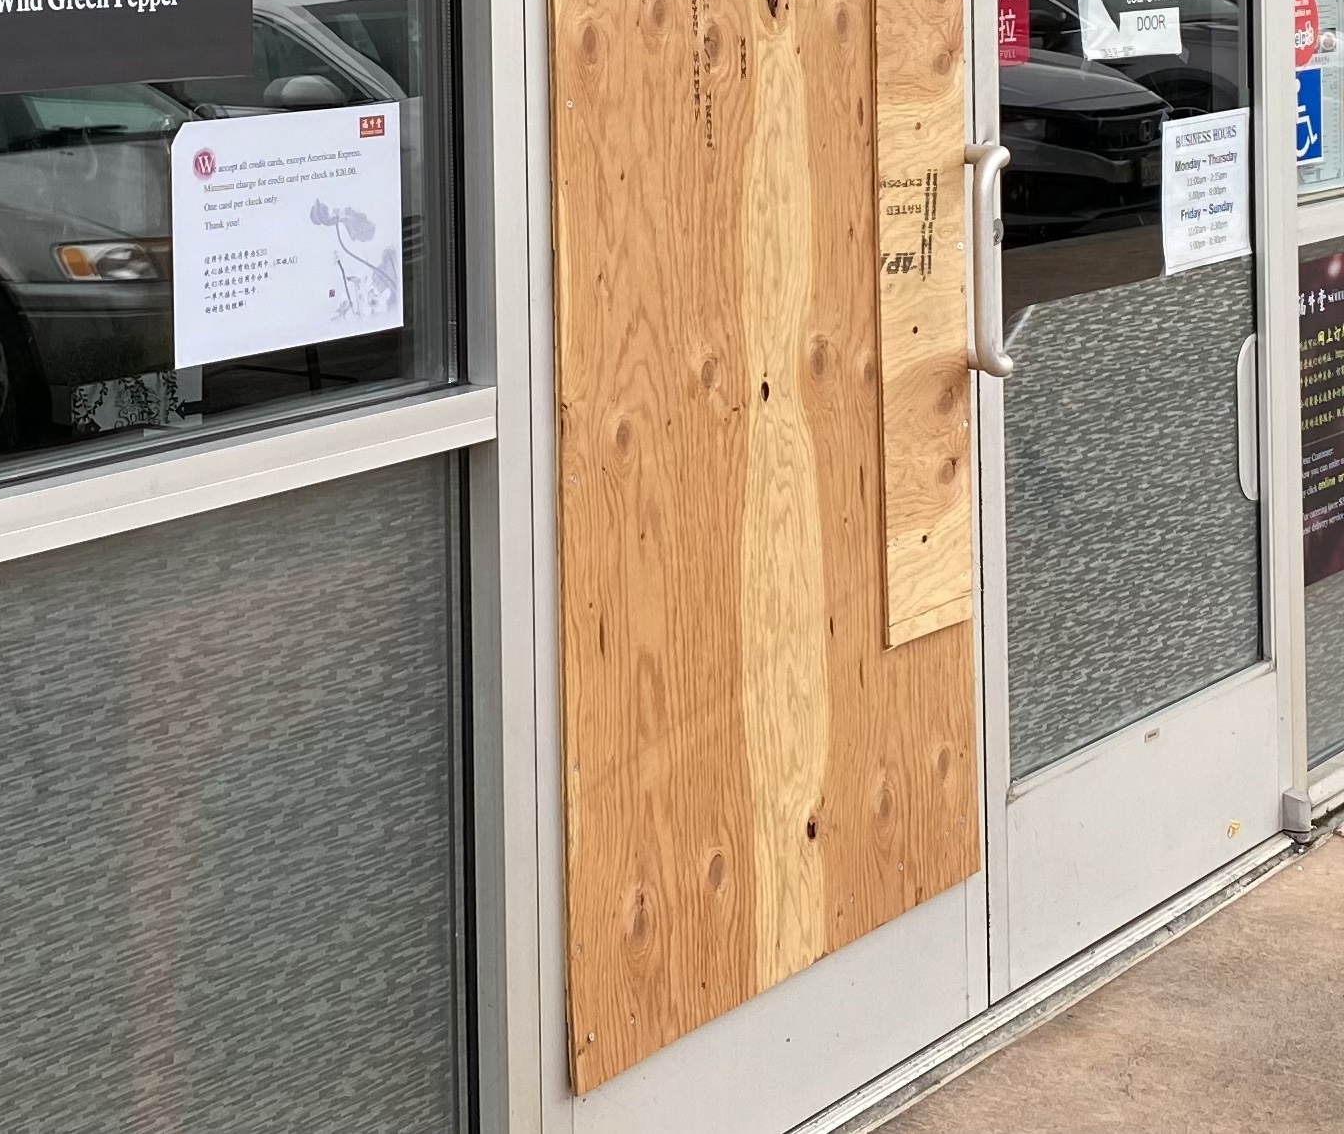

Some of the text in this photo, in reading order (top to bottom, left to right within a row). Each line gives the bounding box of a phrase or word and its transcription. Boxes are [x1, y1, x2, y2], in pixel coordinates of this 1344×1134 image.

[999, 8, 1017, 44] 拉
[1137, 14, 1166, 32] DOOR
[1176, 124, 1237, 149] BUSINESS HOURS
[307, 152, 336, 163] American
[1174, 150, 1238, 173] Monday Thursday
[286, 173, 299, 183] card
[204, 202, 217, 212] One
[219, 199, 232, 210] card
[886, 203, 922, 215] RATED
[1180, 200, 1234, 222] Friday Sunday
[205, 220, 224, 231] Thank
